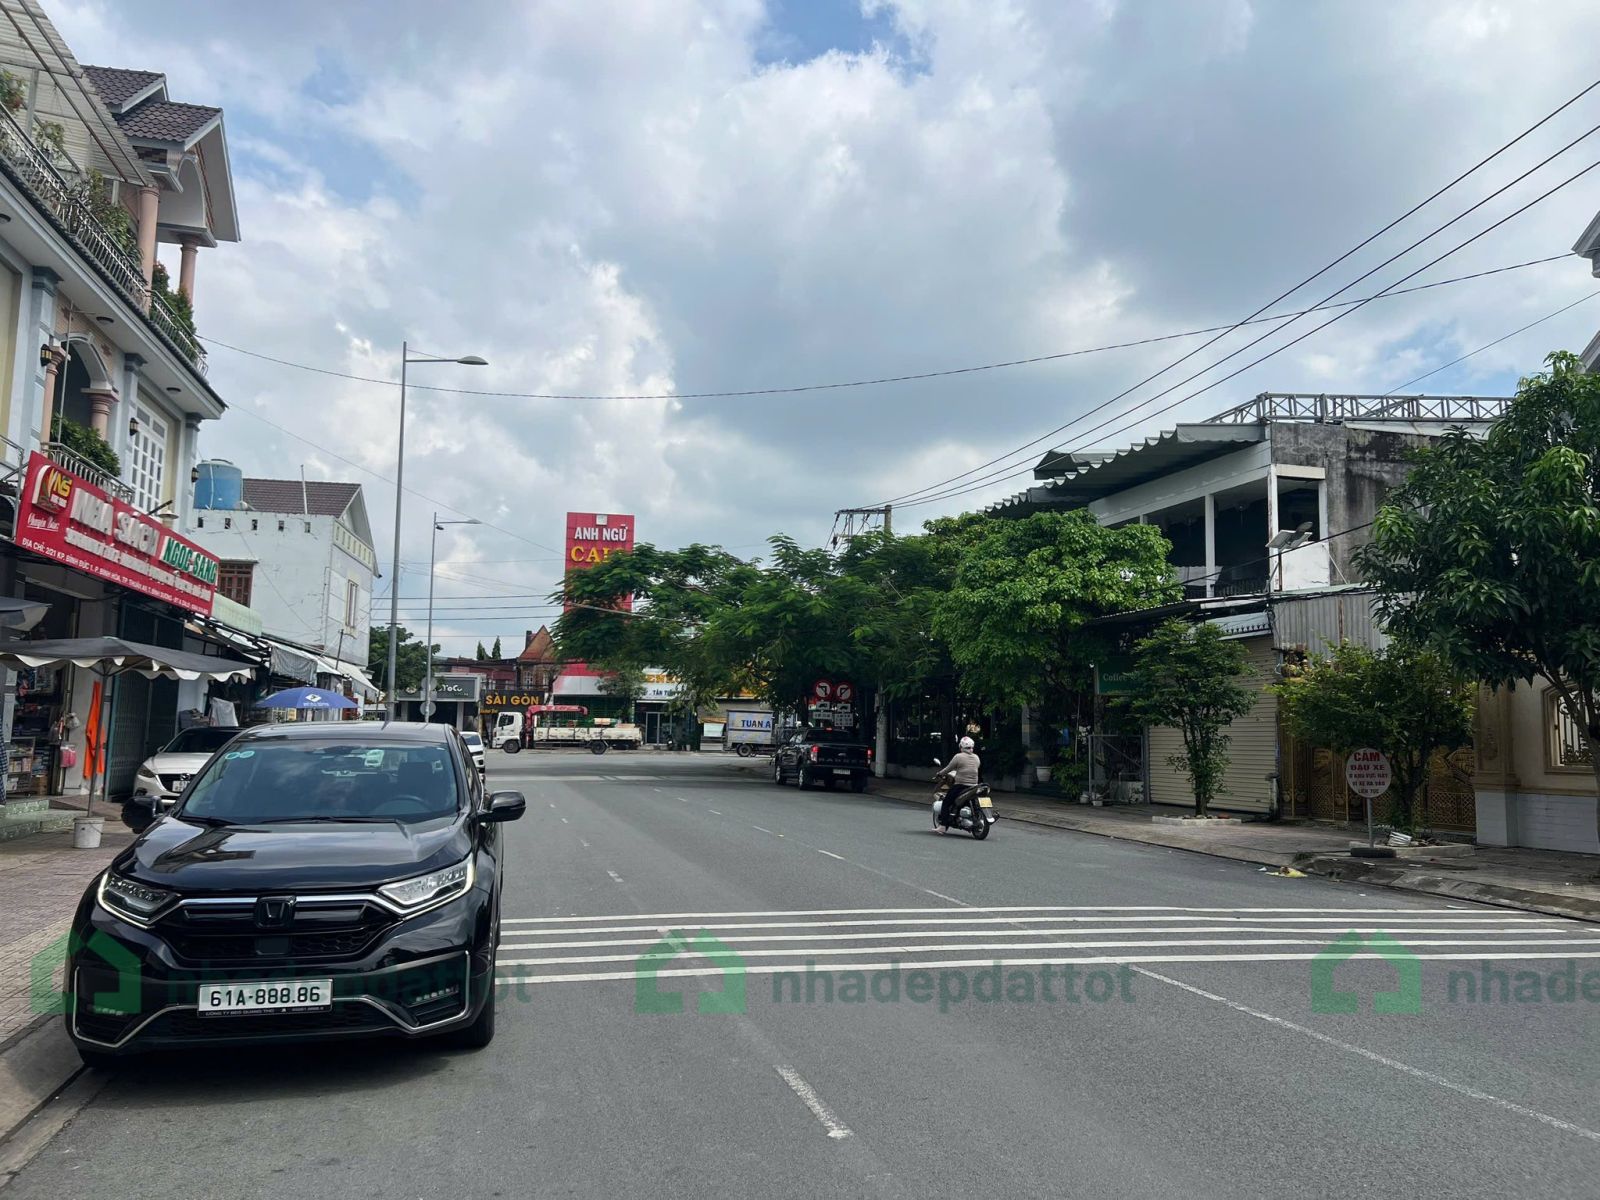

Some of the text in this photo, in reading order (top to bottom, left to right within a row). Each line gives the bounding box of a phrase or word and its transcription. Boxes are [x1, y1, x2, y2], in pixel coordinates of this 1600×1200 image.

[575, 523, 628, 541] ANH NGỮ
[193, 551, 218, 585] SANG
[485, 692, 539, 705] SÀI GÒN
[741, 719, 764, 728] TUAN
[210, 986, 321, 1007] 61A-888.86
